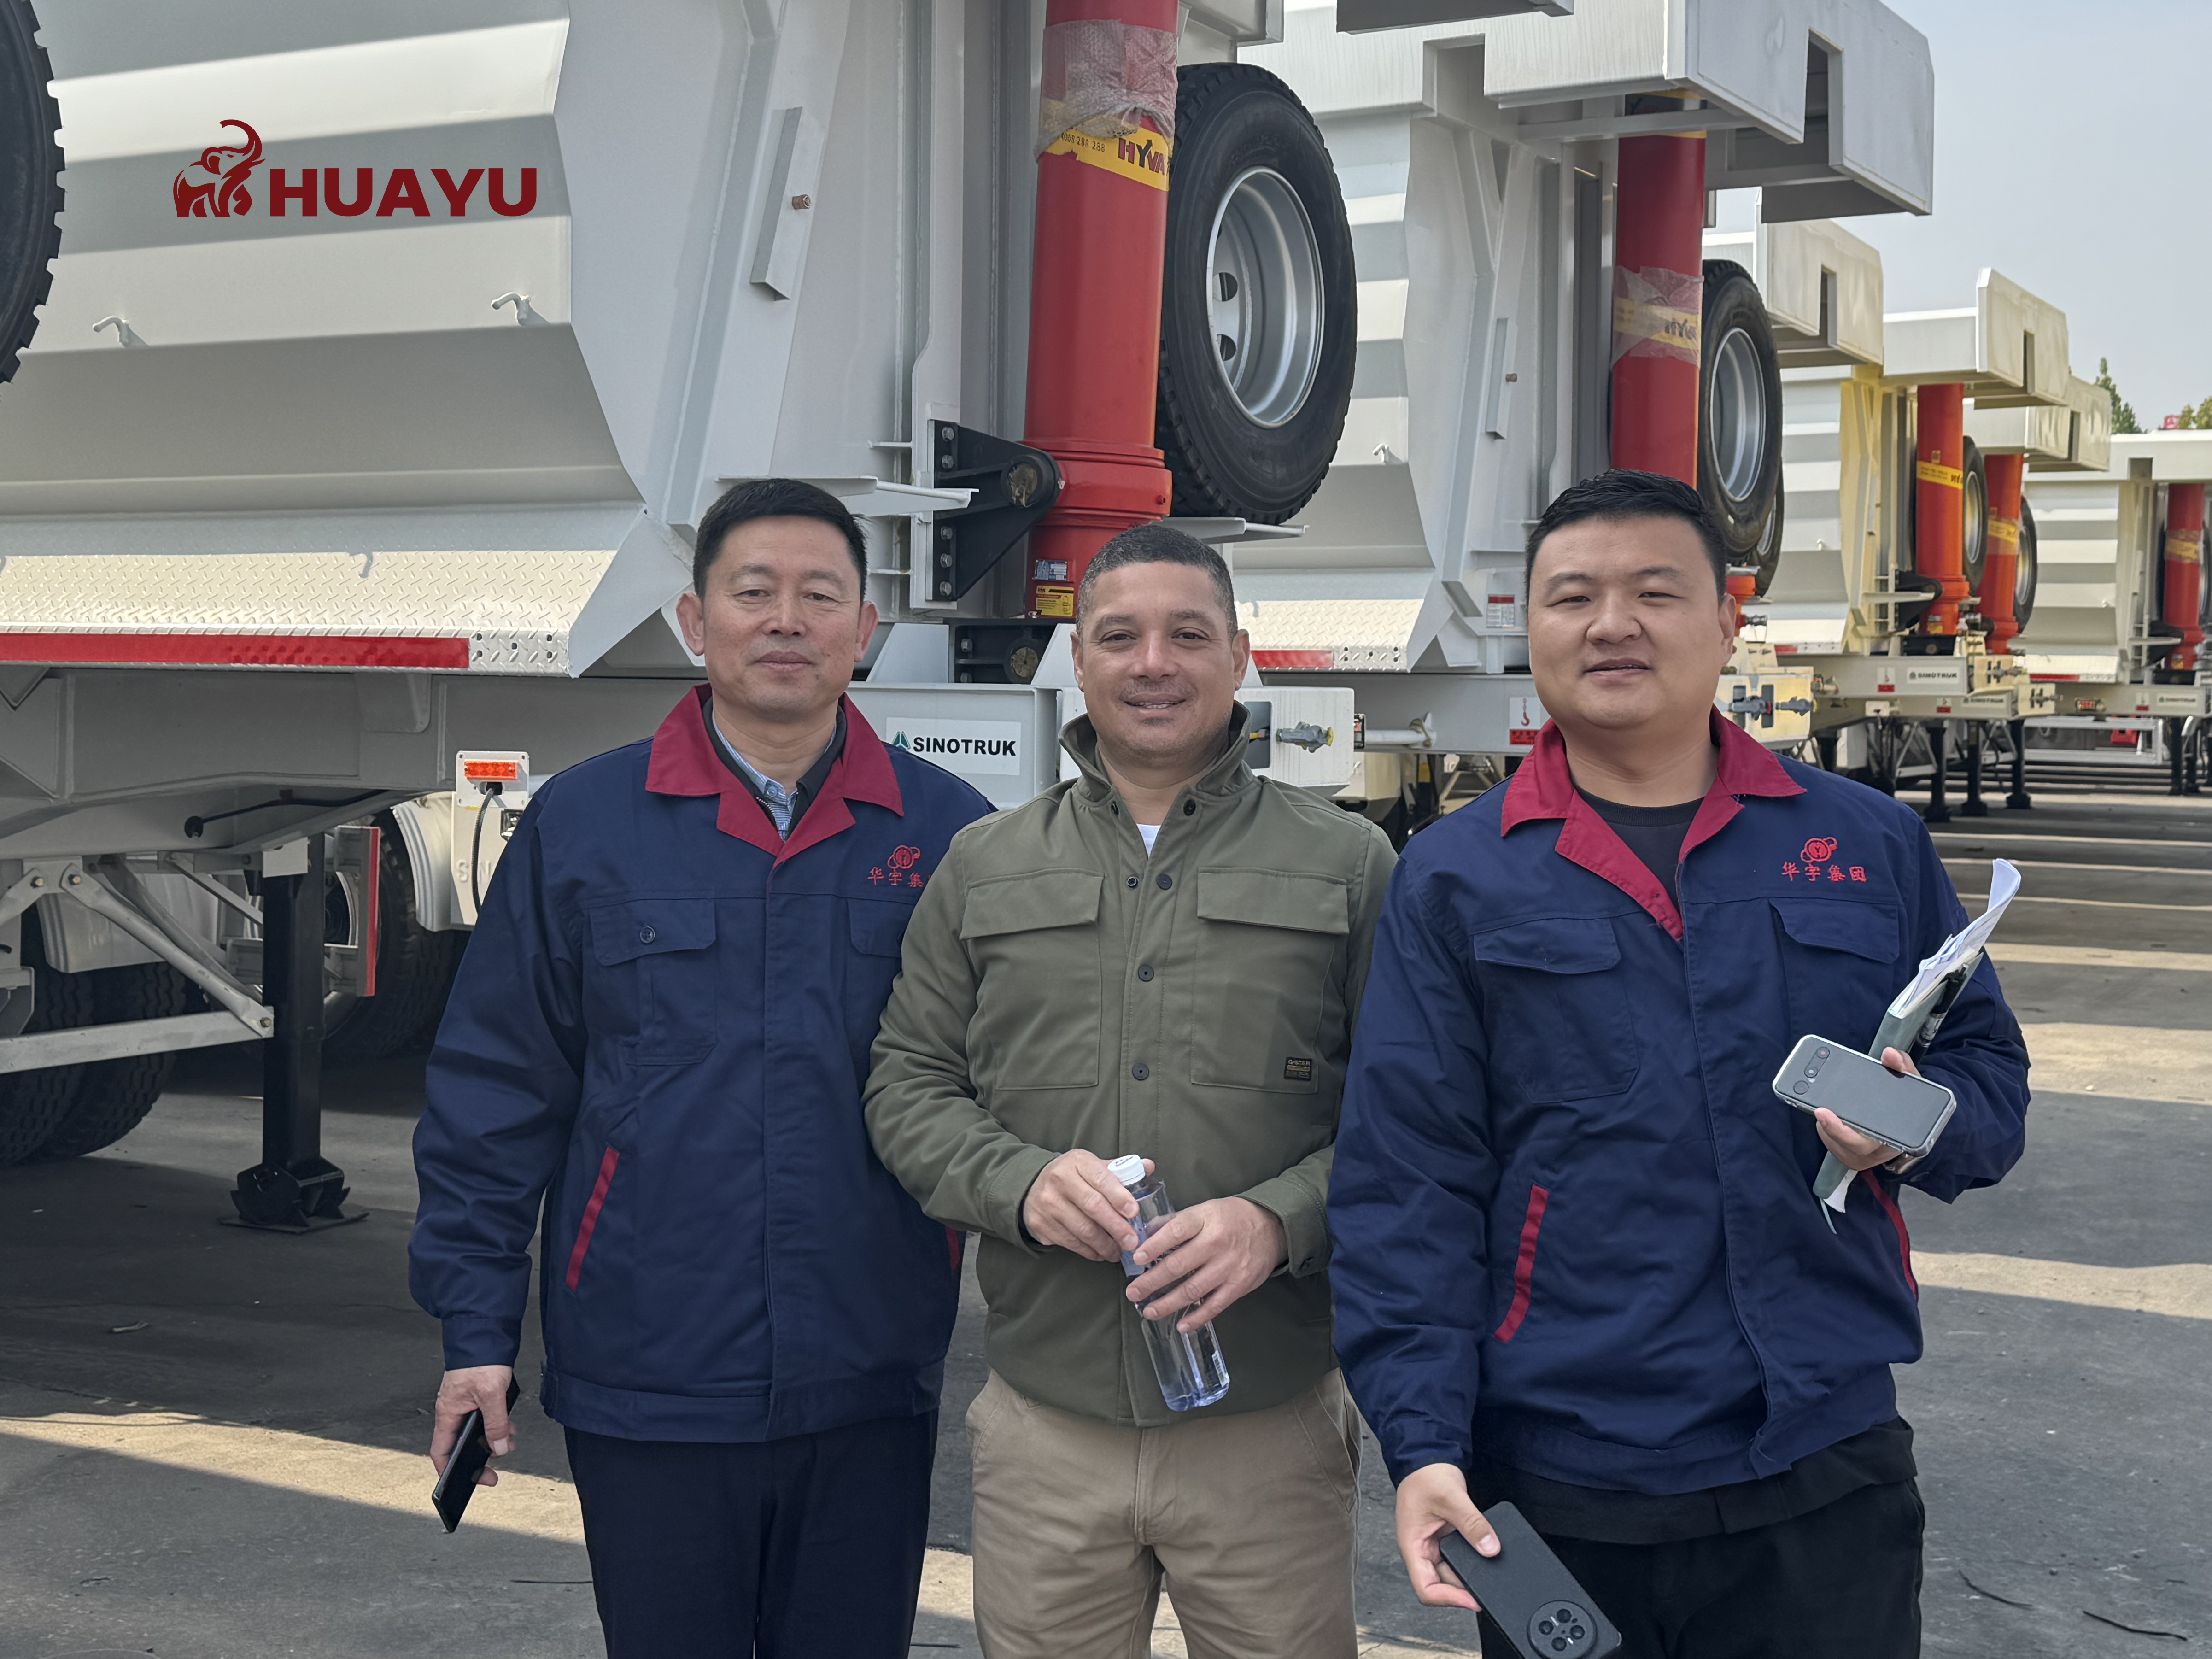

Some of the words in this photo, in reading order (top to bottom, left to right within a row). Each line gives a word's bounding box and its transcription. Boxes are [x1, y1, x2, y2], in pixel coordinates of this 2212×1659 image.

[1092, 141, 1105, 152] 288
[1118, 137, 1165, 176] HYVA
[913, 737, 1016, 756] SINOTRUK
[1781, 861, 1867, 883] 华宇集团
